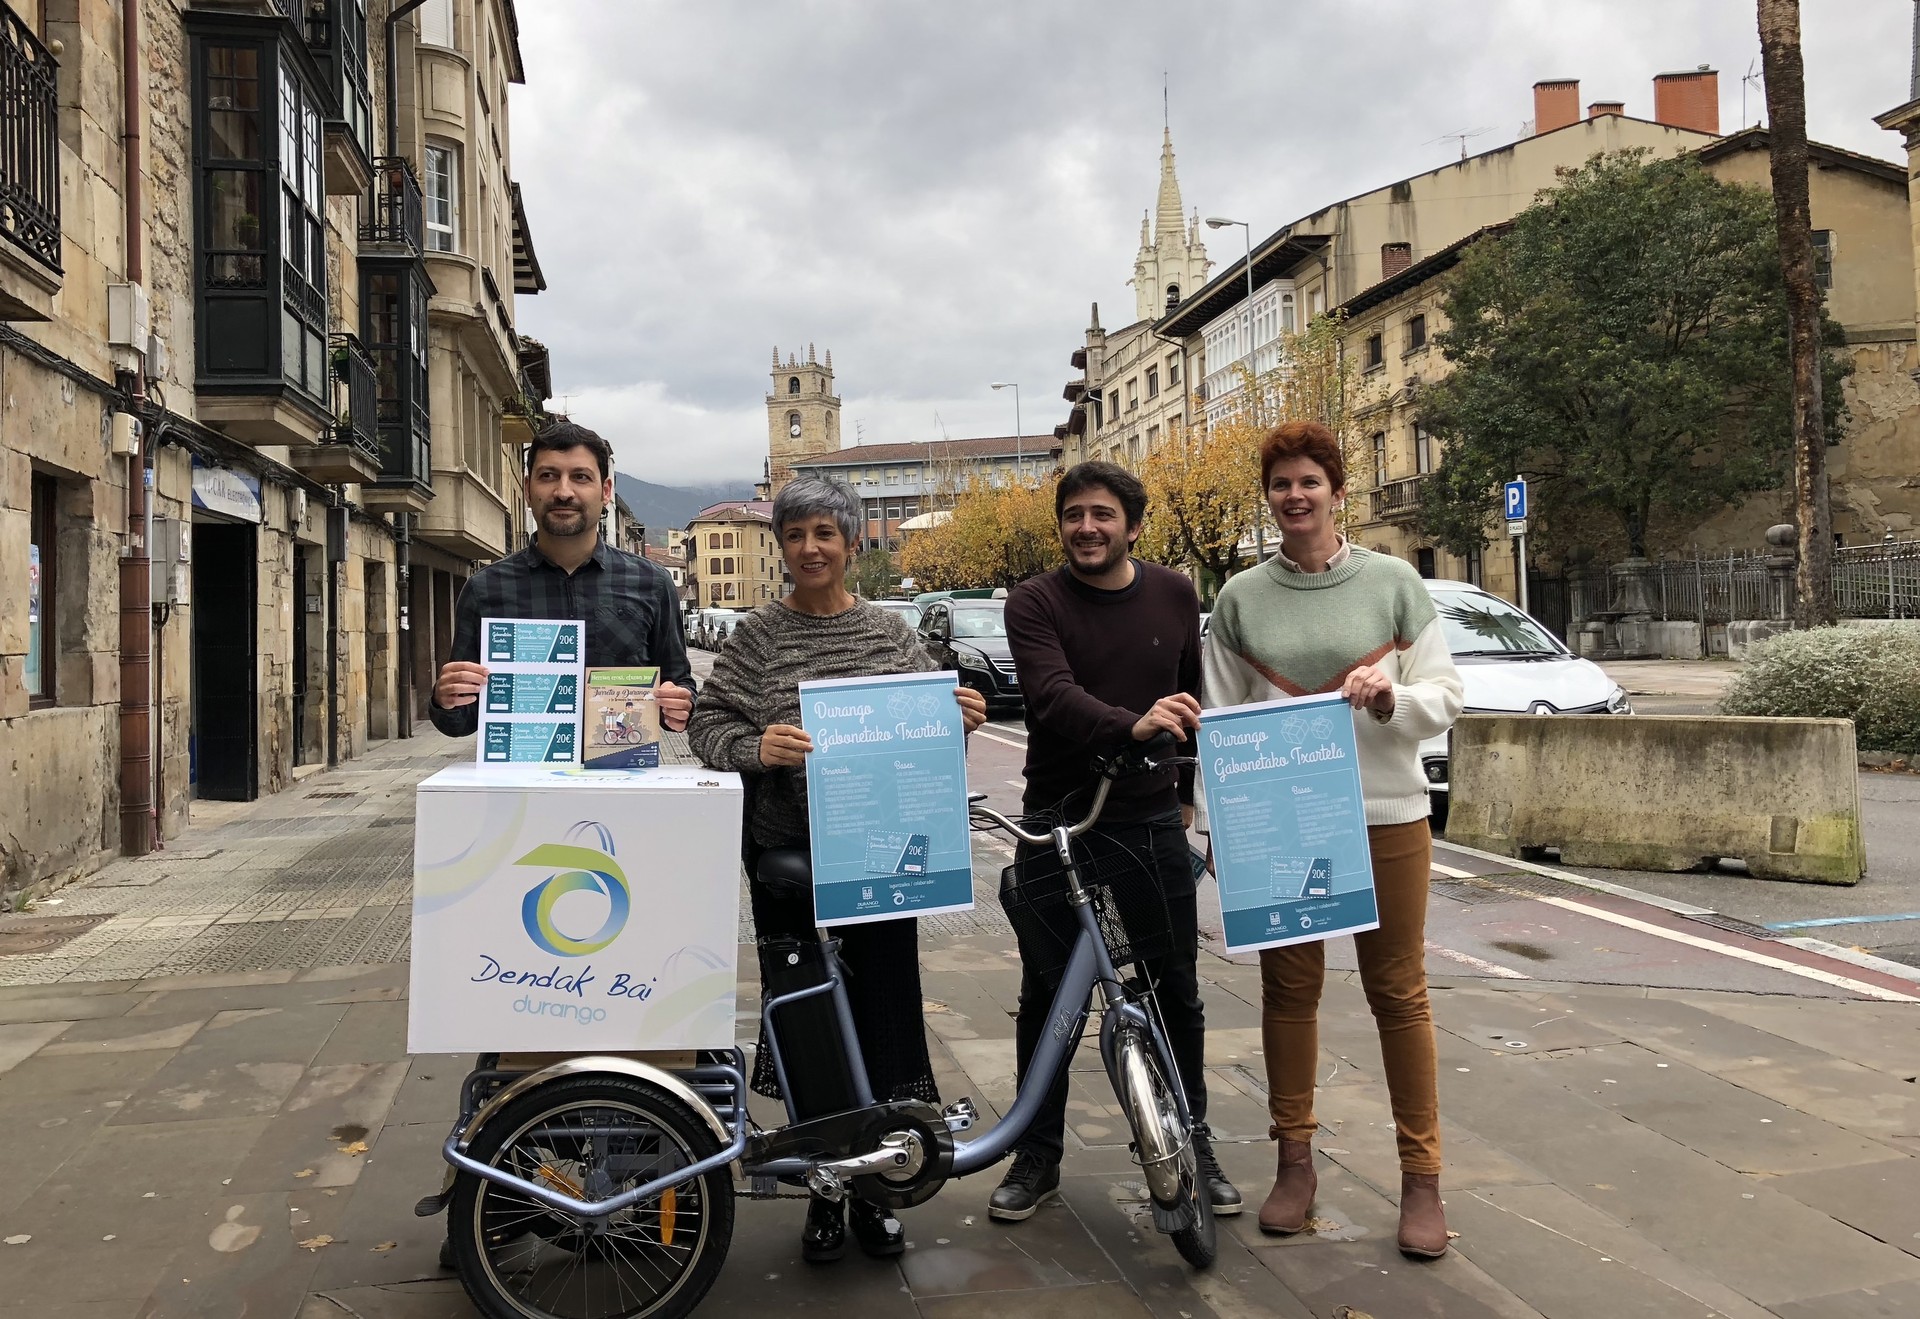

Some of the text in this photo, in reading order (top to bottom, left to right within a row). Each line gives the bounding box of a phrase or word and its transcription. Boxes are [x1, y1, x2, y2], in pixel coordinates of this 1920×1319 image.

[1508, 487, 1520, 514] P
[560, 635, 575, 645] 20€
[558, 685, 574, 695] 20€
[814, 701, 874, 724] Durango
[556, 734, 572, 743] 20€
[817, 720, 951, 753] Gabonetako Txartela
[1209, 730, 1268, 751] Durango
[1214, 742, 1345, 783] Gabonetako Txartela
[908, 845, 923, 855] 20€
[1312, 869, 1326, 879] 20€
[471, 954, 657, 1001] Dendak Bai
[513, 995, 607, 1025] durango
